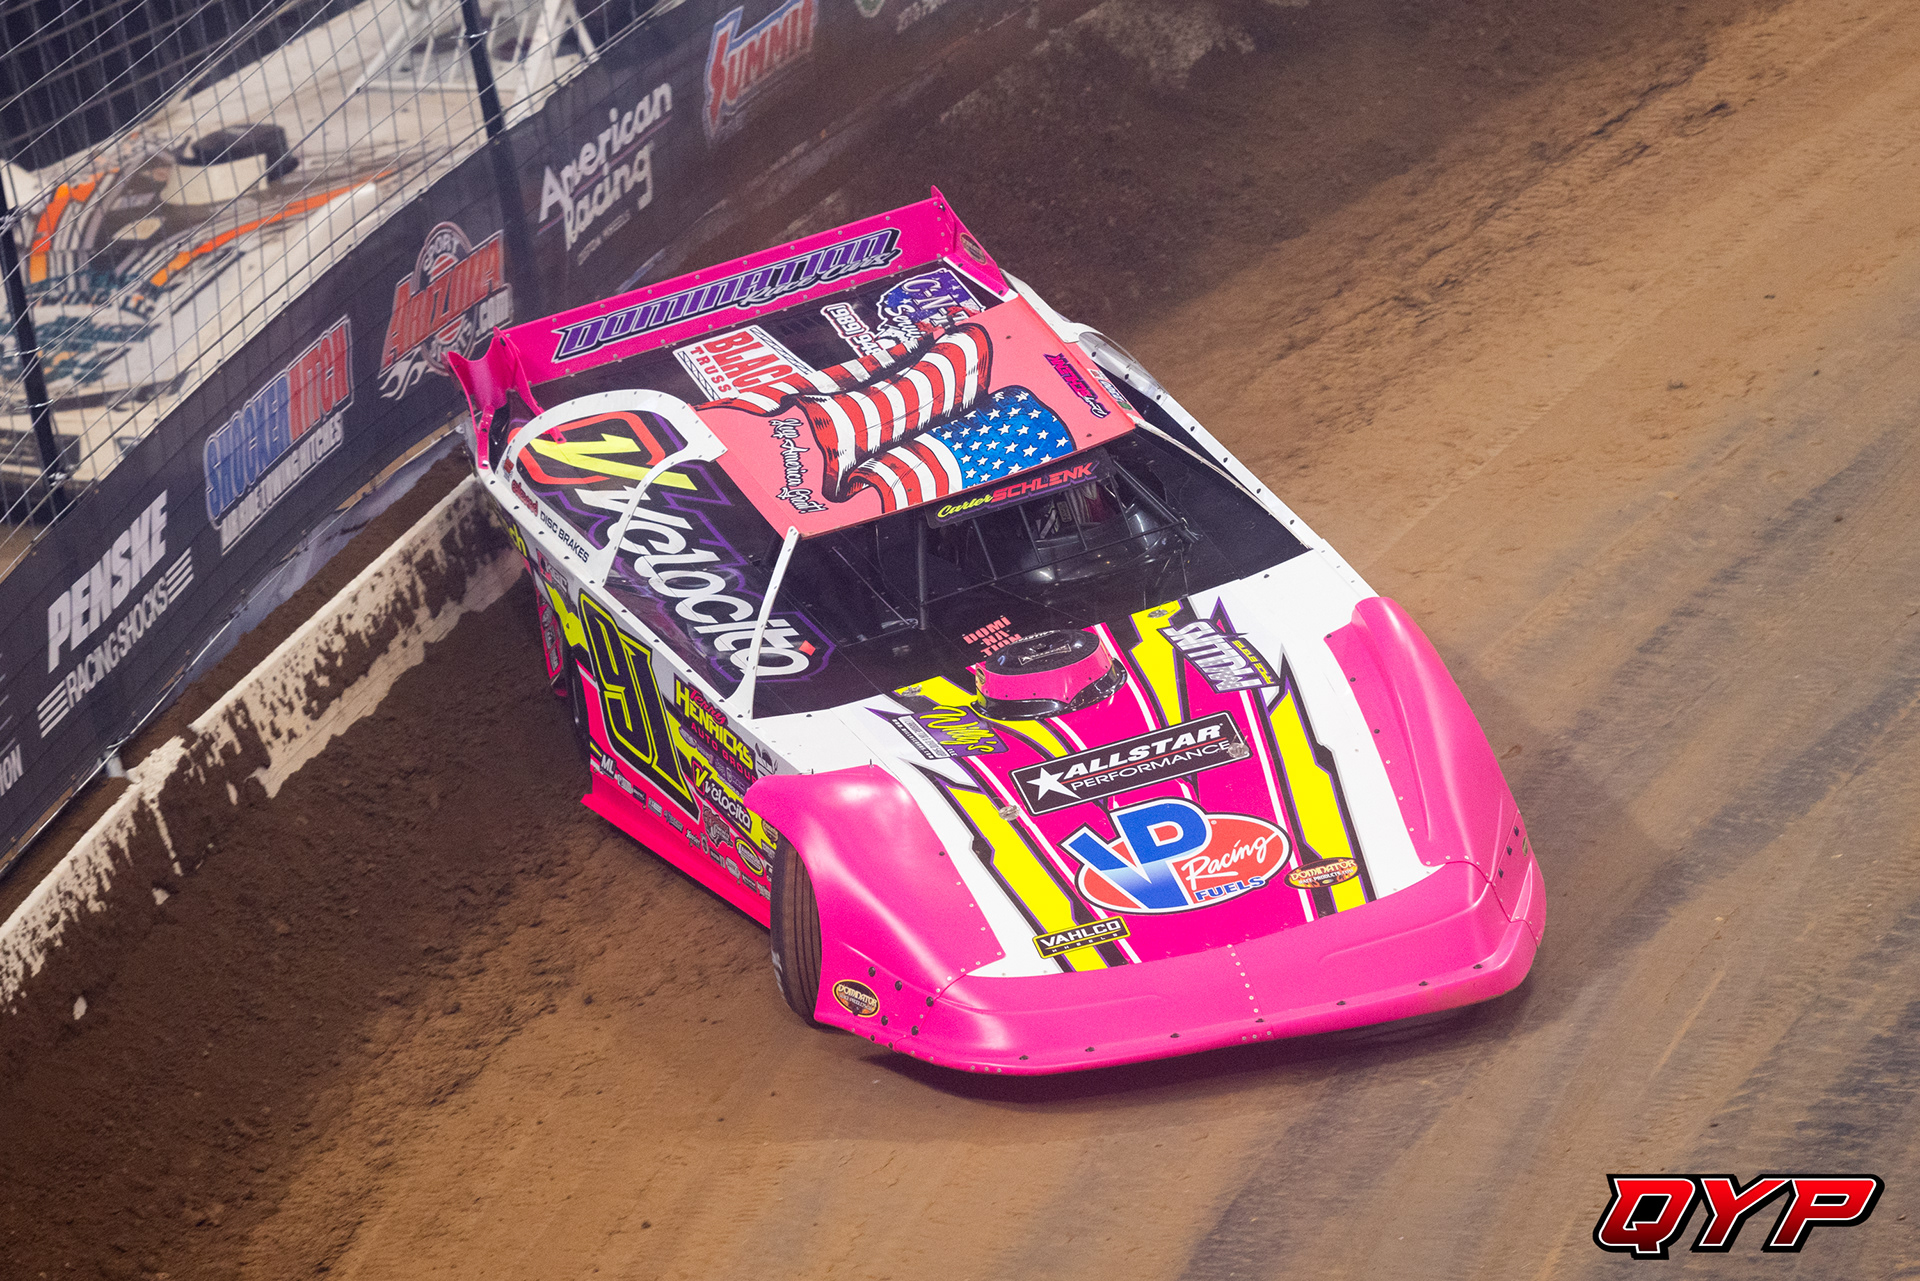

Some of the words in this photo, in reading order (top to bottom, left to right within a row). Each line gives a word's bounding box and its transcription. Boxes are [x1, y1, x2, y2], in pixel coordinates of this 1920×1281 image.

[706, 0, 815, 134] SUMMIT
[539, 83, 672, 223] American
[563, 141, 655, 251] Racing
[556, 230, 898, 360] DOMINATION
[827, 303, 865, 336] (989)
[690, 346, 732, 392] TRUSS
[780, 438, 810, 488] America
[991, 462, 1093, 503] SCHLENK
[776, 486, 828, 514] Great!
[540, 511, 558, 533] DISC
[558, 529, 590, 563] BRAKES
[48, 490, 167, 673] PENSKE
[65, 632, 117, 709] RACING
[115, 575, 169, 658] SHOCKS
[1161, 620, 1263, 692] MULLINS
[675, 679, 754, 770] HENRICKS
[691, 722, 718, 752] AUTO
[920, 705, 998, 753] Willy's
[1062, 724, 1221, 779] ALLSTAR
[1071, 739, 1231, 791] PERFORMANCE
[1067, 803, 1208, 910] VP
[1181, 835, 1275, 890] Racing
[1290, 860, 1357, 881] DOMINATOR
[1195, 876, 1265, 901] FUELS
[1040, 920, 1121, 947] VAHLCO
